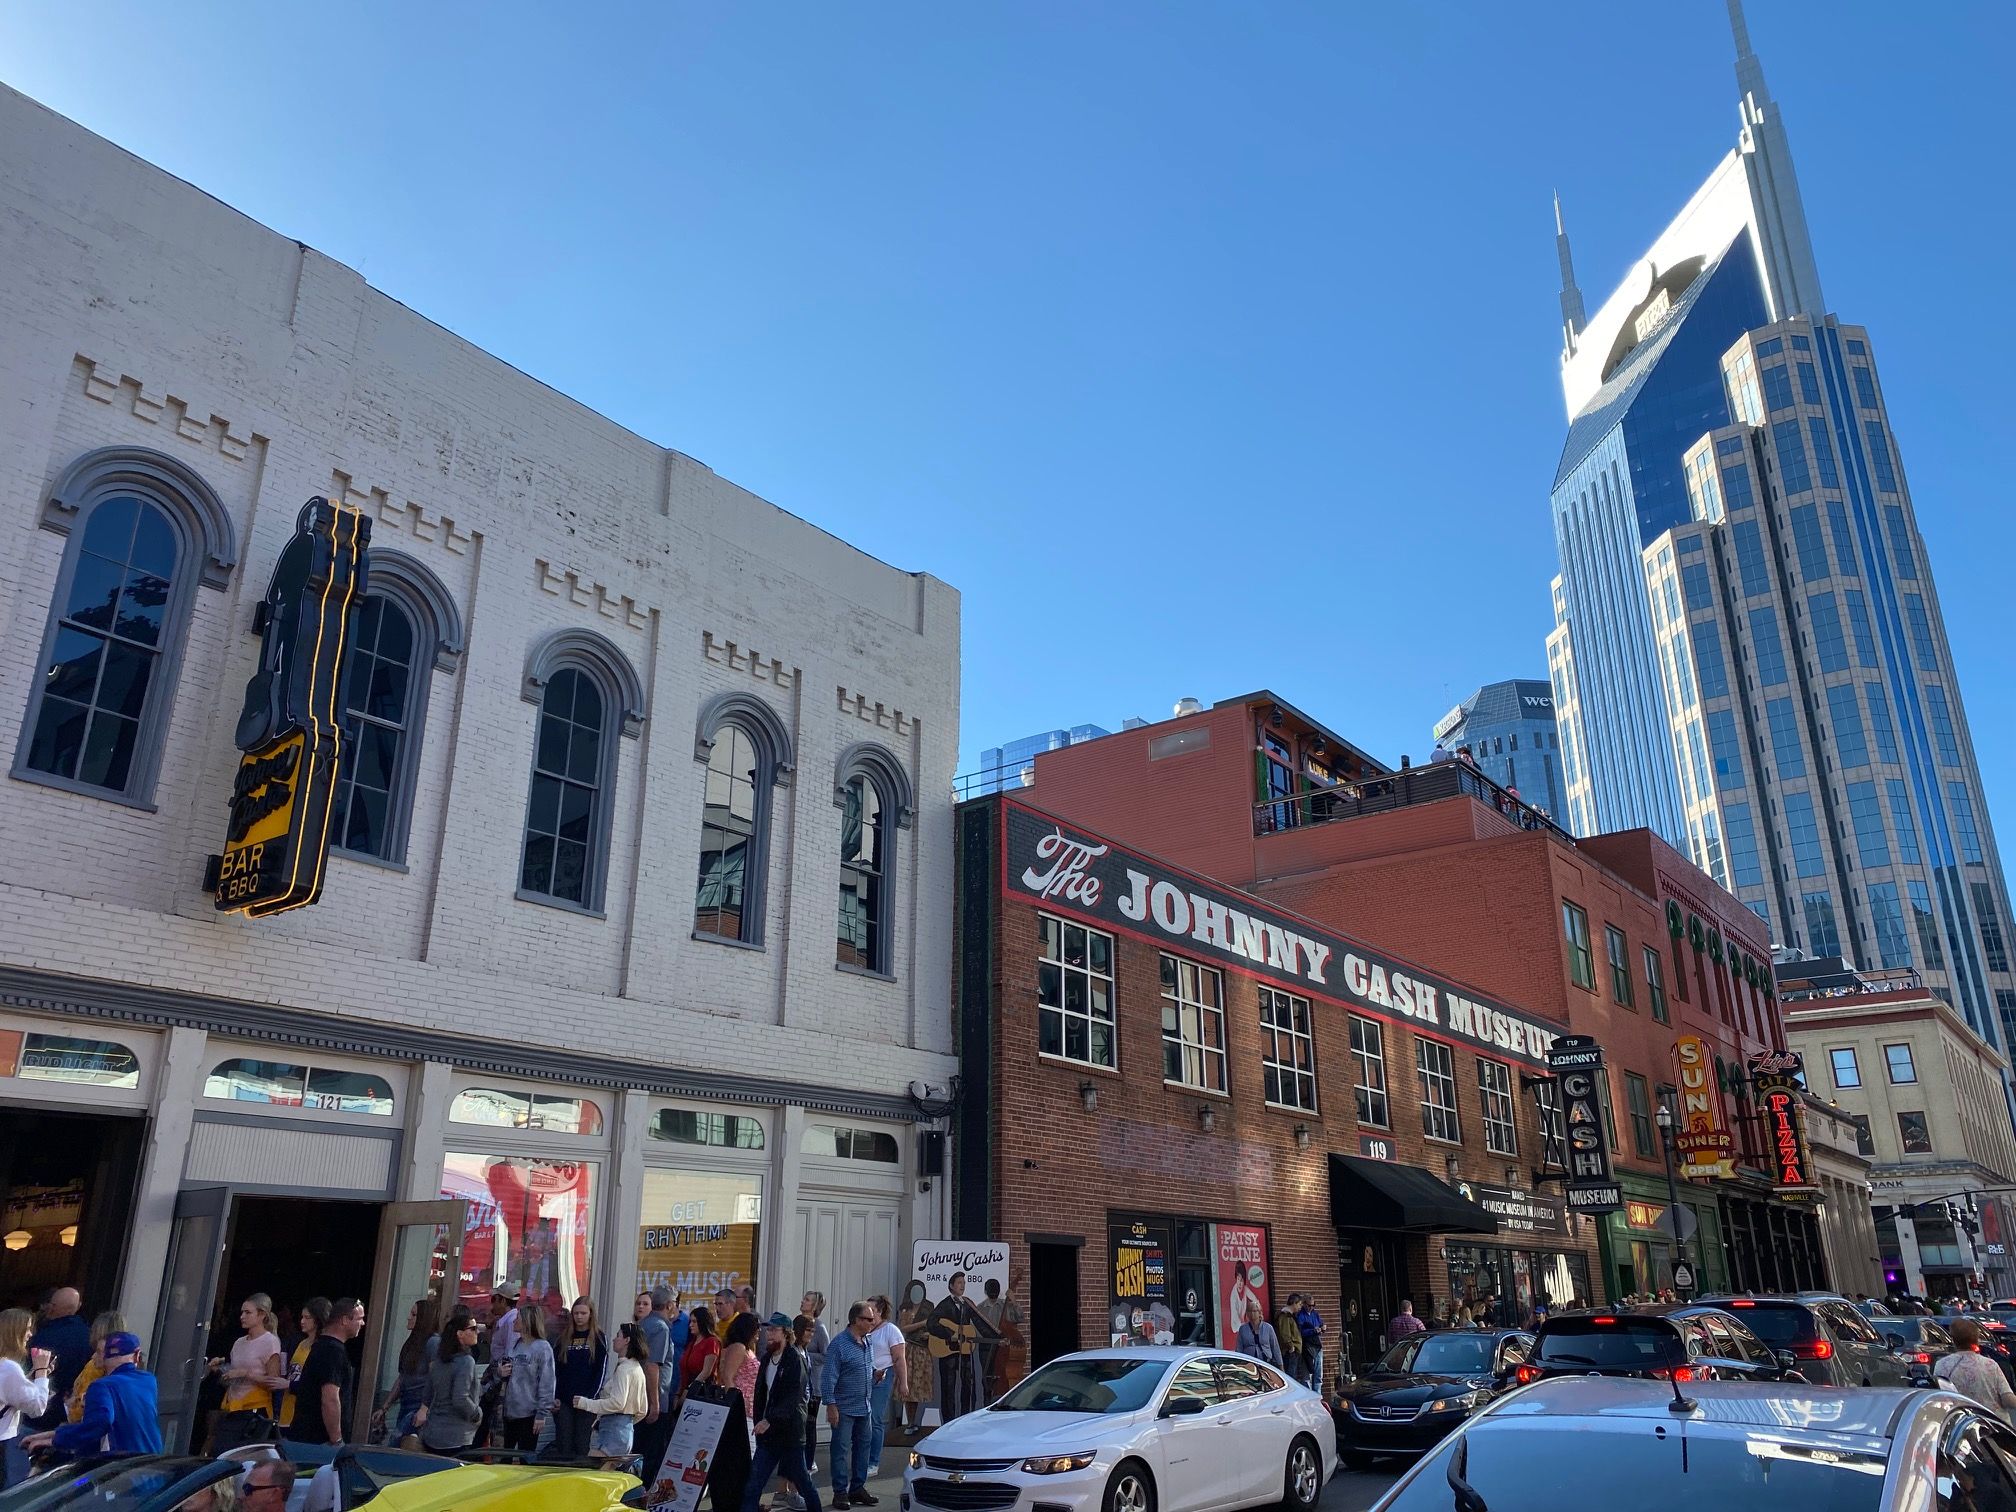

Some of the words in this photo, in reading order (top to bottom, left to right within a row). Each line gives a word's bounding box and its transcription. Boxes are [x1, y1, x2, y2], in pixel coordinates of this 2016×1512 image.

[220, 842, 265, 880] BAR
[216, 882, 224, 903] &
[228, 872, 260, 900] BBQ
[1022, 826, 1108, 907] The
[1117, 868, 1329, 984] JOHNNY
[1343, 953, 1439, 1025] CASH
[25, 1054, 62, 1068] BUD
[64, 1057, 118, 1072] LIGHT
[1551, 1052, 1598, 1066] JOHNNY
[1679, 1042, 1709, 1114] SUN
[1757, 1075, 1795, 1090] CITY
[320, 1094, 343, 1111] 121
[1564, 1074, 1602, 1176] CASH
[1677, 1134, 1731, 1150] DINER
[1770, 1094, 1804, 1183] PIZZA
[1369, 1140, 1387, 1160] 119
[1687, 1164, 1723, 1177] OPEN
[1568, 1188, 1619, 1206] MUSEUM
[672, 1200, 707, 1221] GET
[1489, 1200, 1506, 1214] MUSIC
[1506, 1202, 1528, 1217] MUSEUM
[1528, 1205, 1534, 1218] IN
[1534, 1206, 1556, 1220] AMERICA
[1630, 1205, 1647, 1224] SUN
[1648, 1208, 1664, 1225] DIN
[1132, 1225, 1147, 1235] CASH
[1508, 1219, 1514, 1229] BY
[1514, 1219, 1522, 1229] USA
[1521, 1220, 1534, 1230] TODAY
[645, 1223, 729, 1250] RHYTHM!
[1223, 1230, 1259, 1247] PATSY
[918, 1251, 964, 1272] Johnny
[963, 1249, 1004, 1272] Cash's
[1116, 1247, 1144, 1272] JOHNNY
[1146, 1249, 1164, 1258] SHIRTS
[1221, 1246, 1261, 1263] CLINE
[926, 1274, 941, 1282] BAR
[967, 1275, 983, 1283] BBQ
[1116, 1260, 1145, 1297] CASH
[1146, 1266, 1164, 1274] PHOTOS
[1146, 1274, 1164, 1285] MUGS
[676, 1271, 740, 1295] MUSIC
